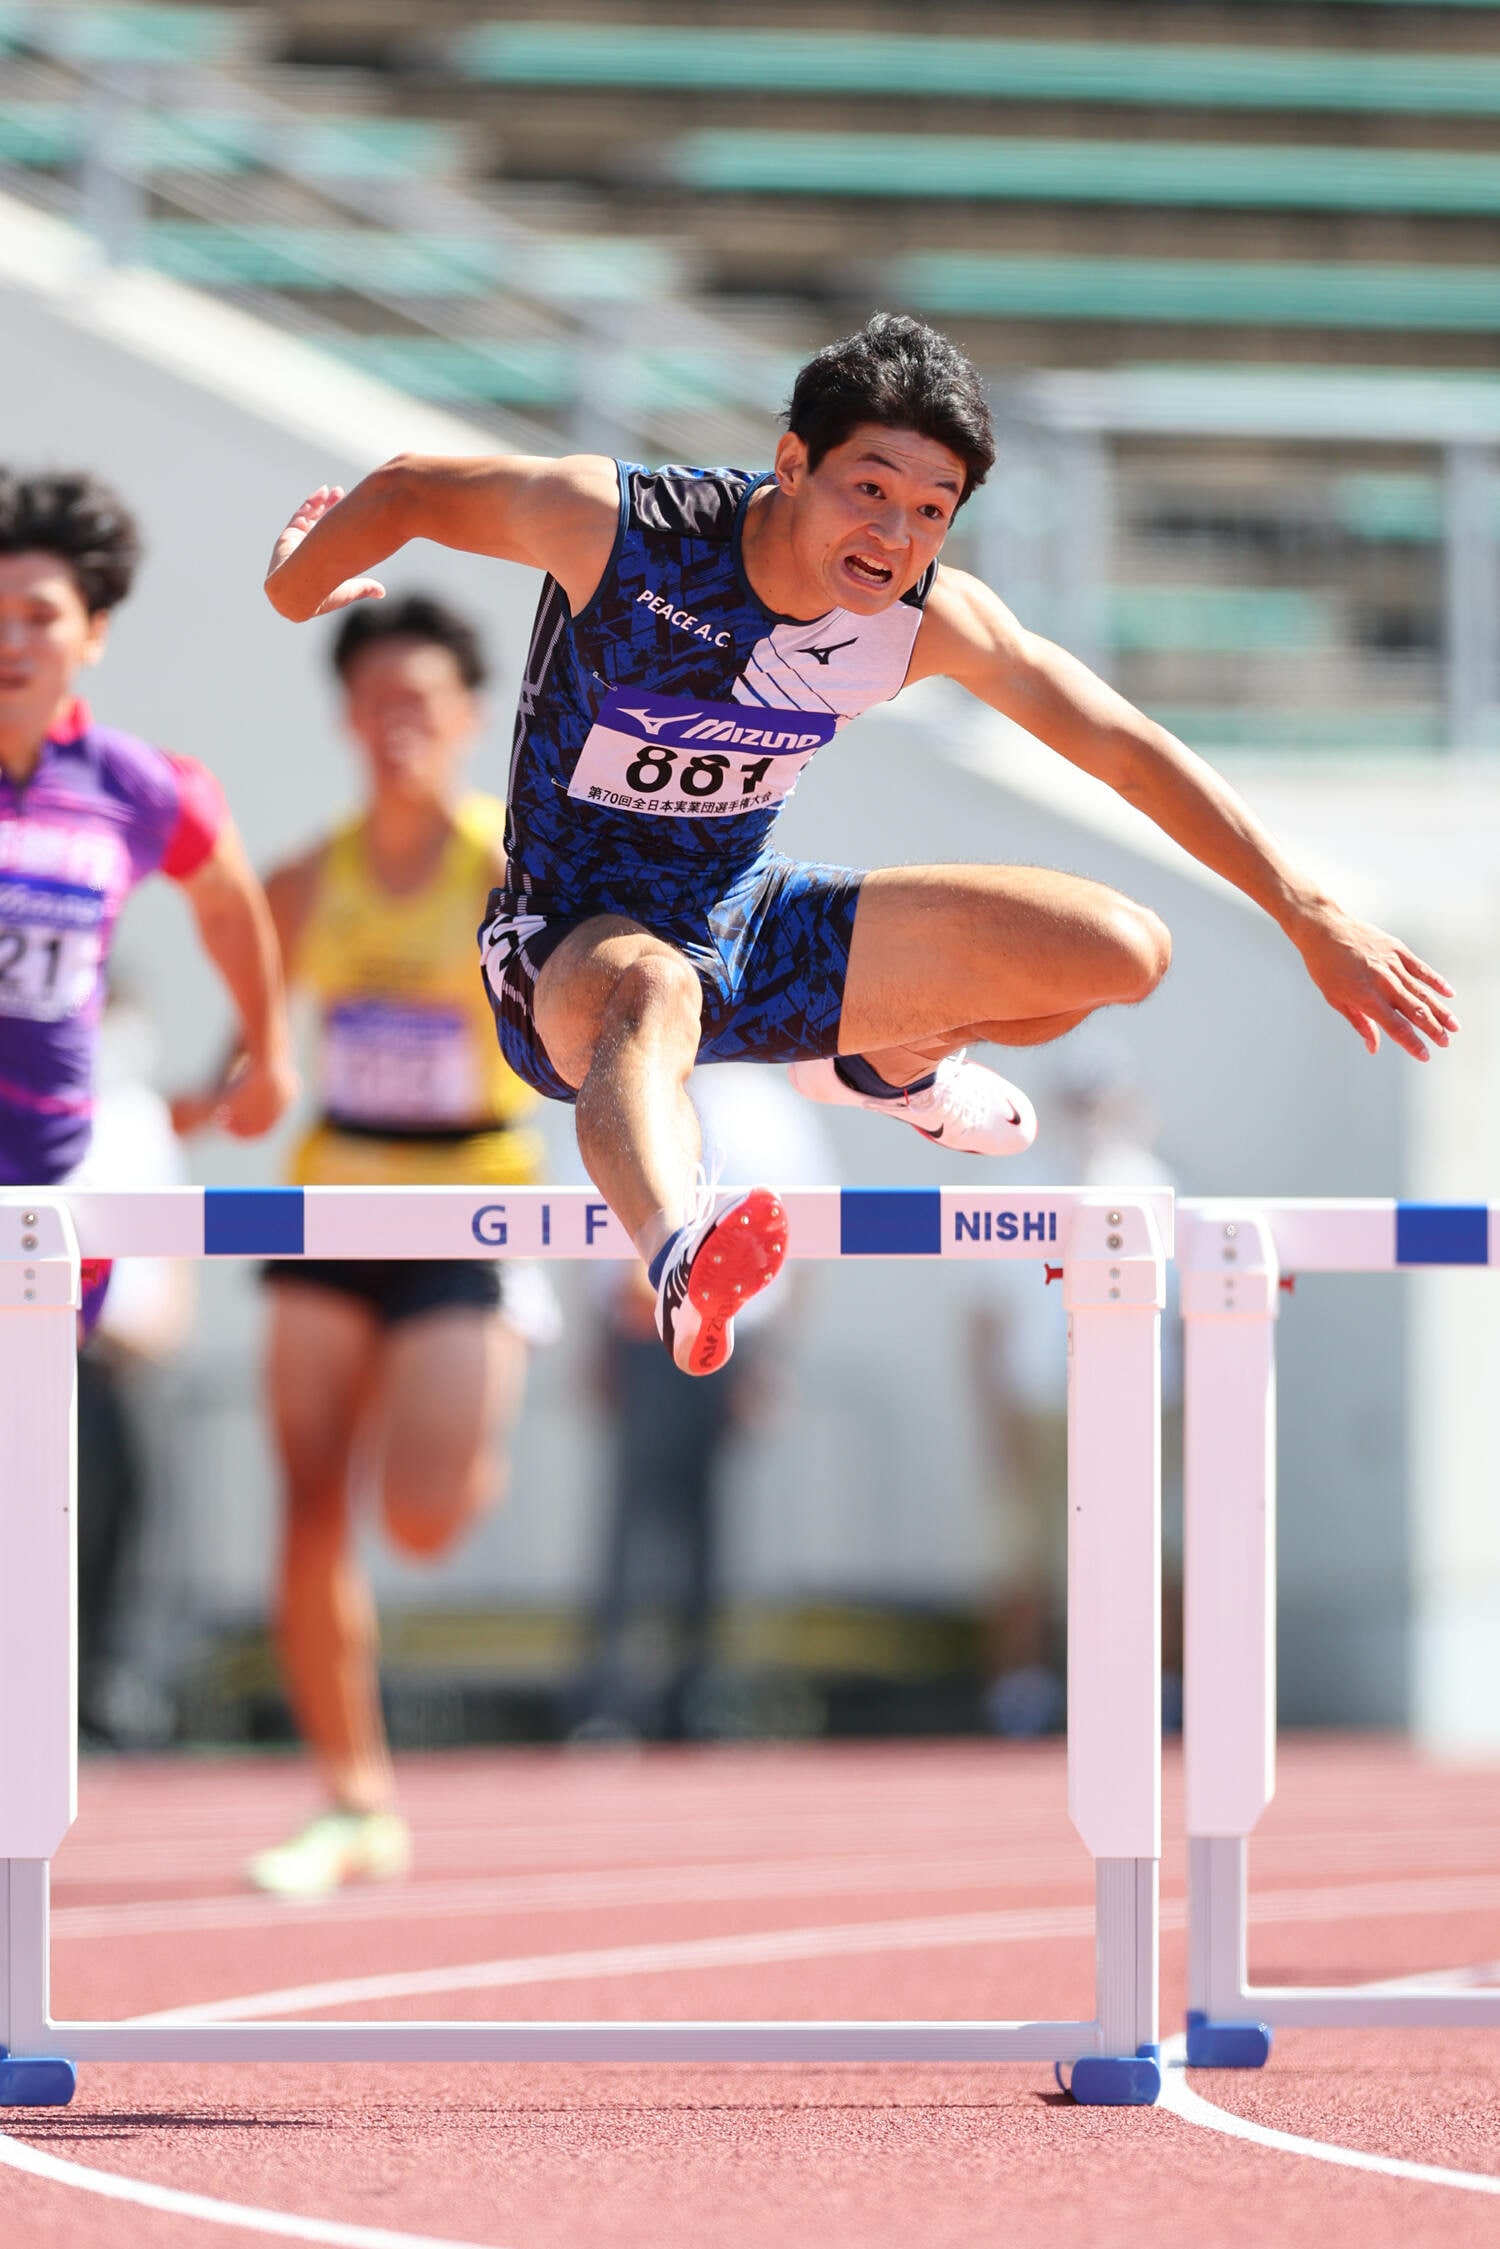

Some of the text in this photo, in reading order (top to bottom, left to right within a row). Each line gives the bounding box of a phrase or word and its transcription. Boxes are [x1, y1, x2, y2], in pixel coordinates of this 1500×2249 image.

[636, 589, 698, 631] PEACE
[625, 746, 774, 797] 881
[587, 786, 772, 813] 第70回全日本実業団選手権大会
[954, 1211, 1057, 1241] NISHI
